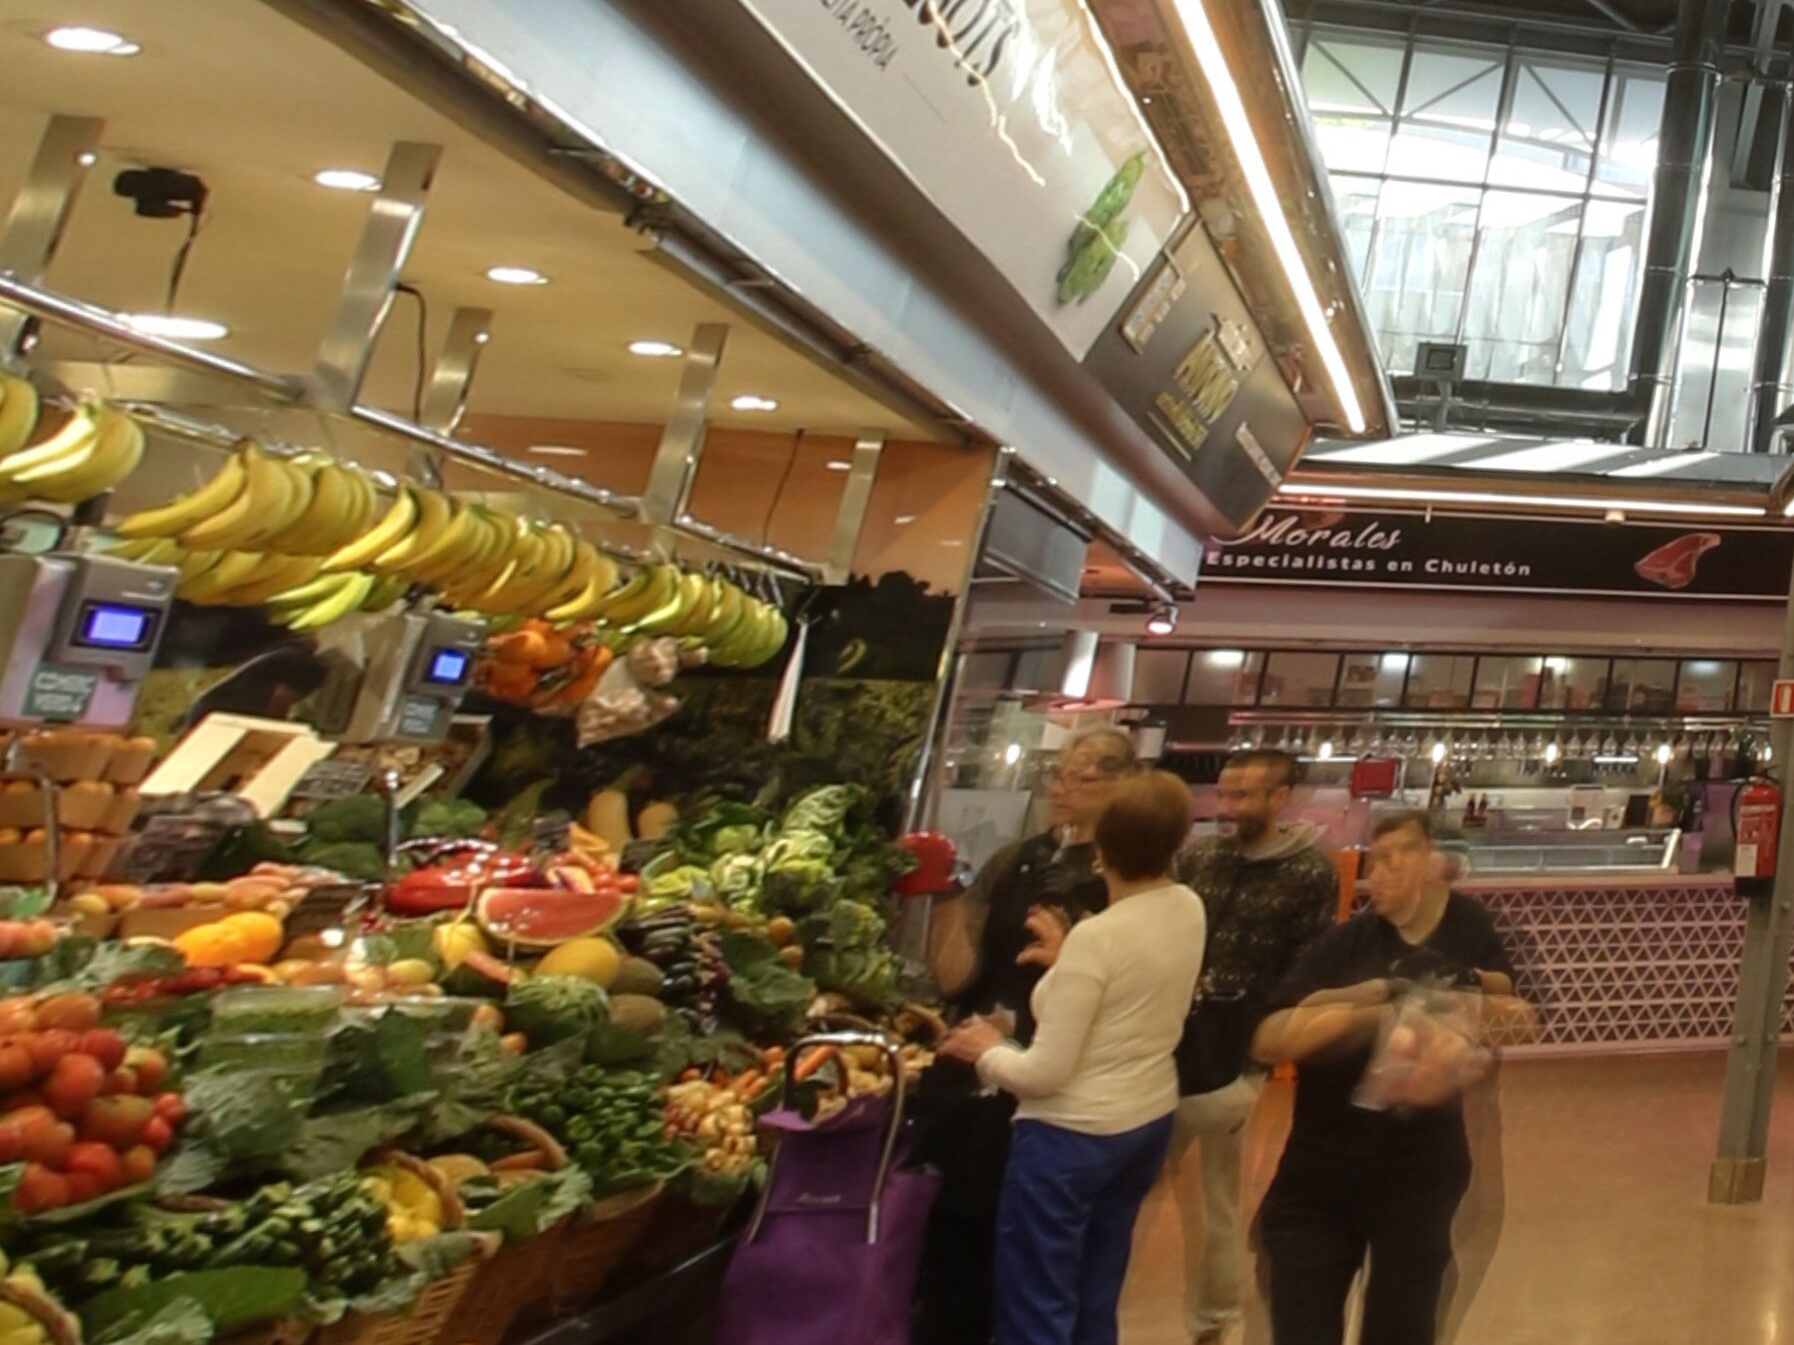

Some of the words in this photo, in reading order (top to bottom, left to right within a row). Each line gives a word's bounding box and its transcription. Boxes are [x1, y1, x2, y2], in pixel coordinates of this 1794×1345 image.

[1210, 514, 1401, 550] Morales
[1206, 551, 1376, 572] Especialistas
[1387, 560, 1413, 573] en
[1424, 557, 1532, 577] Chuletón
